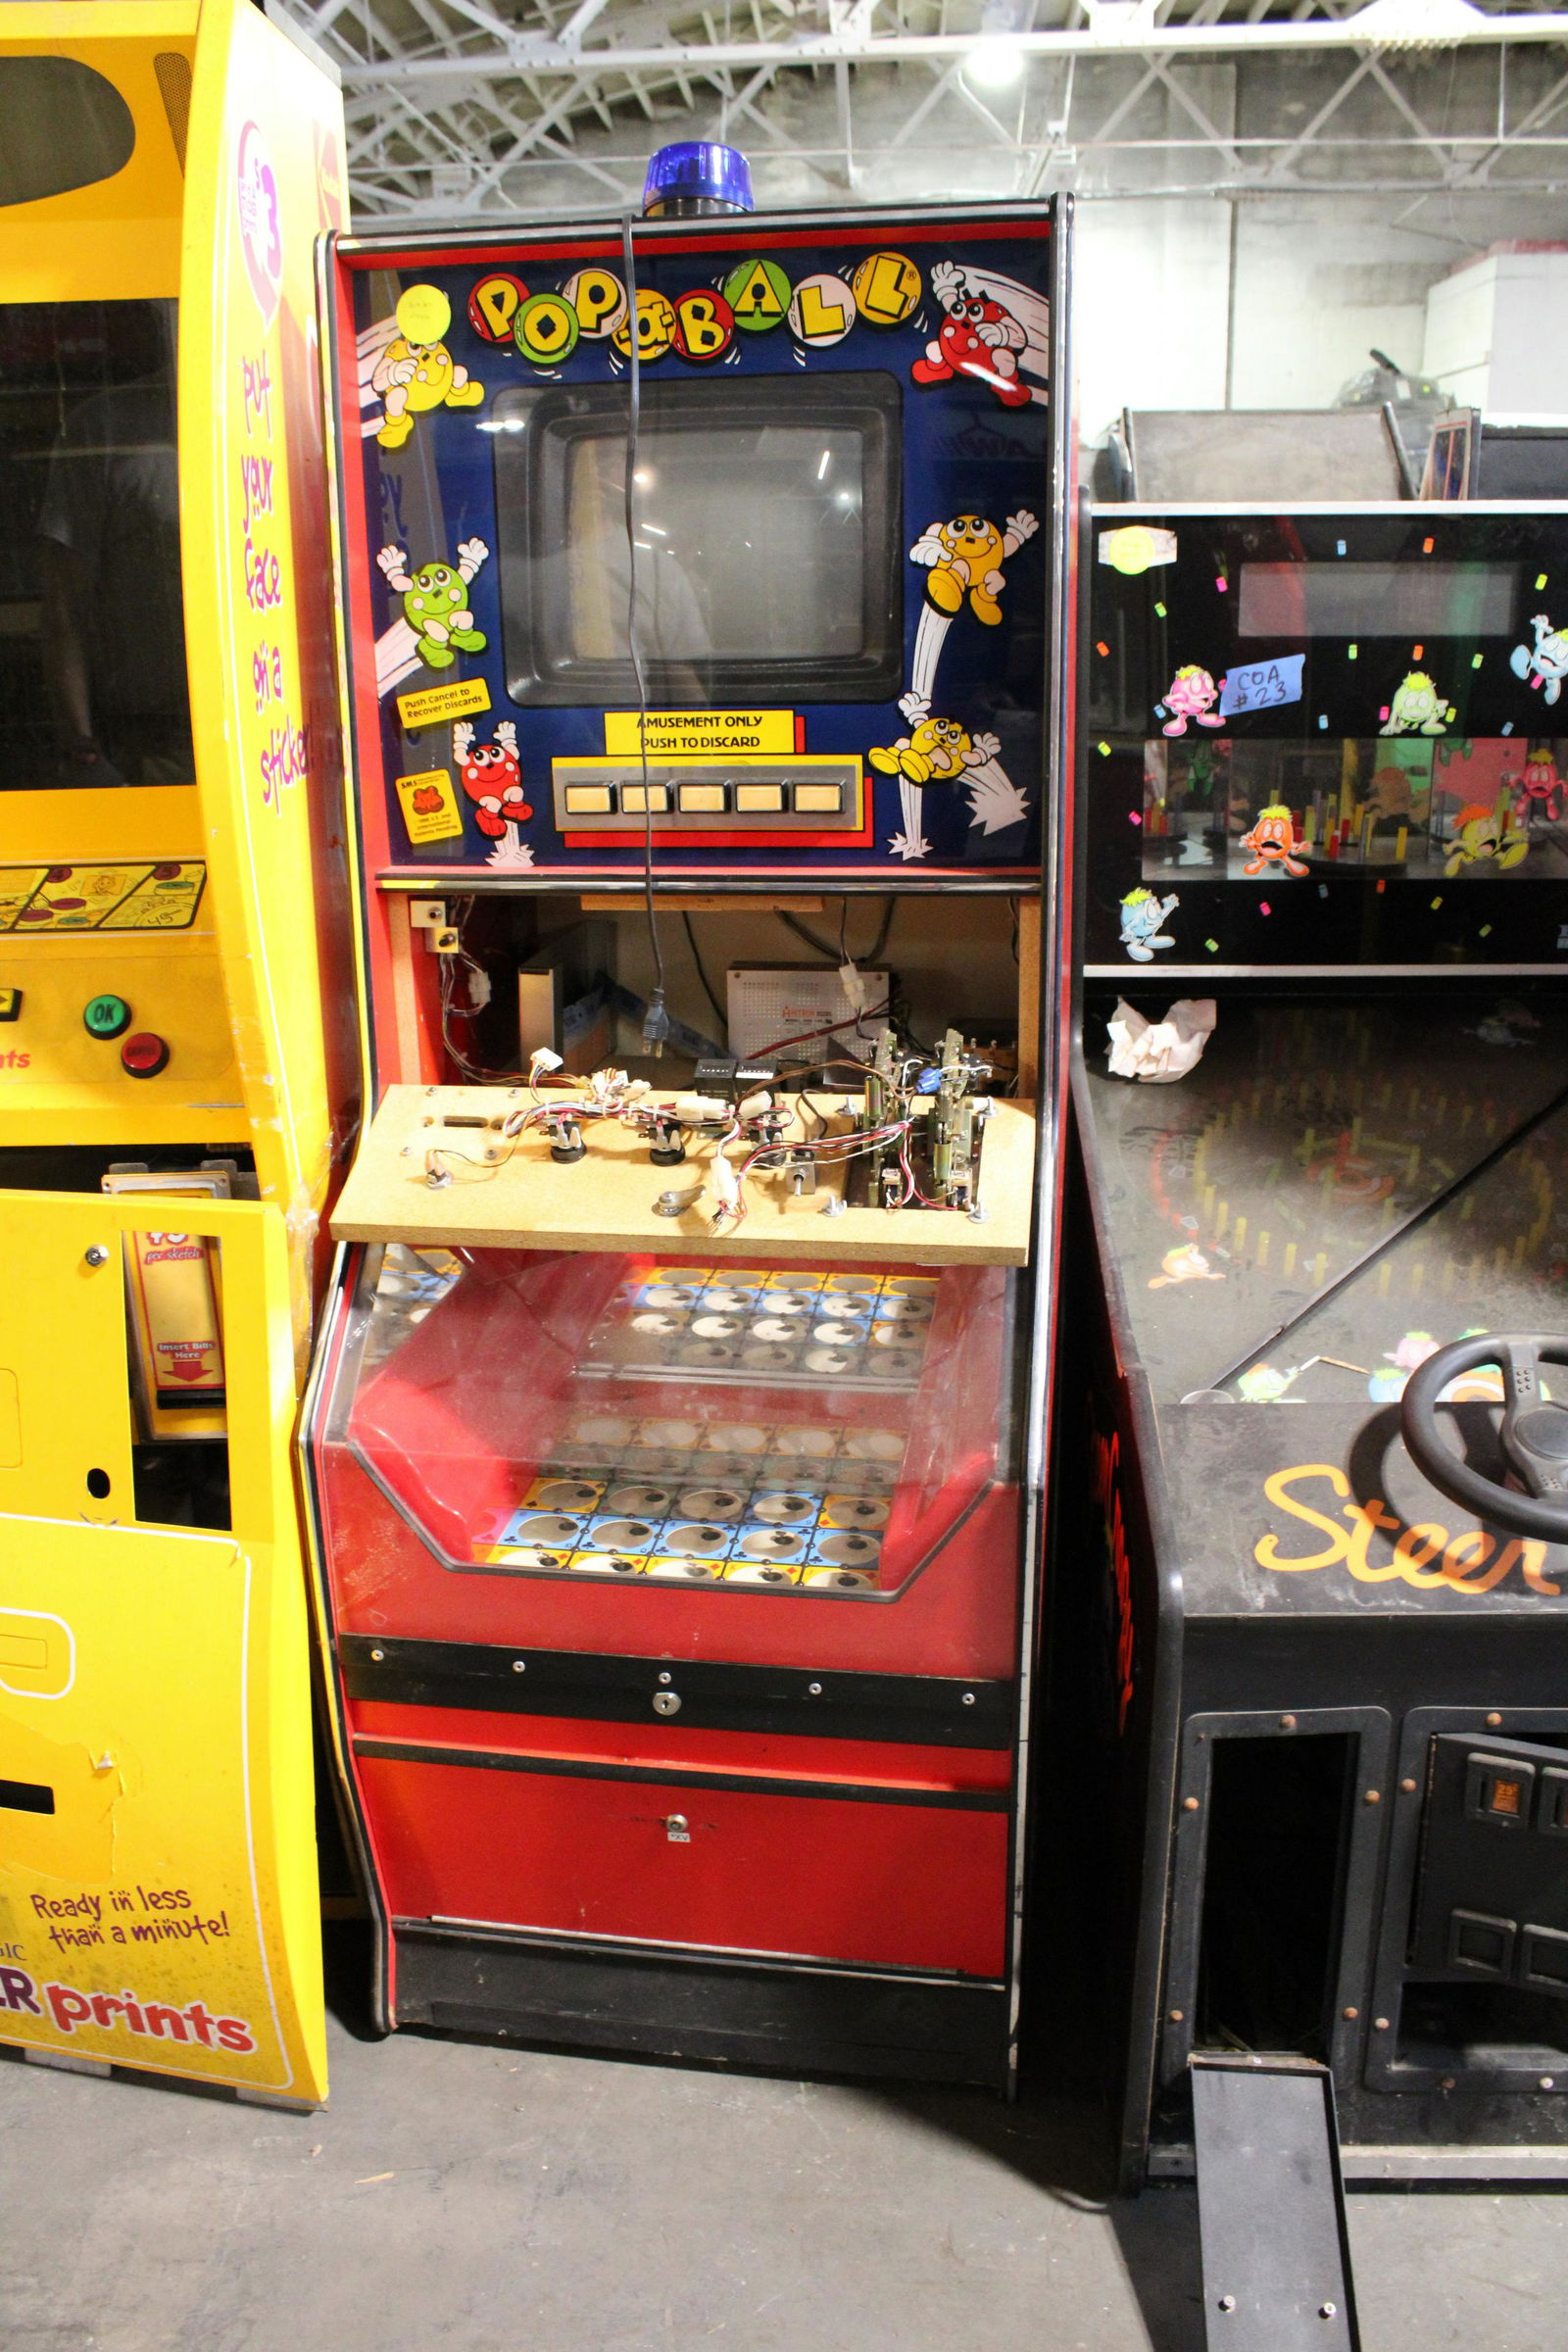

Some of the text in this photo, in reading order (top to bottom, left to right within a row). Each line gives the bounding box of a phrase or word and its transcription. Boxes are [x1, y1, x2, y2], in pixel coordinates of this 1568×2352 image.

[242, 348, 271, 441] put
[240, 454, 273, 535] your
[244, 536, 281, 610] face
[252, 639, 282, 715] on a
[1238, 665, 1279, 691] COA
[404, 698, 426, 710] Push
[428, 690, 458, 704] Cancel
[407, 695, 483, 718] Recover Discards
[637, 715, 762, 728] AMUSEMENT ONLY
[640, 736, 760, 749] PUSH TO DISCARD
[93, 1004, 118, 1023] OK
[146, 1247, 201, 1264] per sketch
[159, 1342, 215, 1351] Insert Bills
[1254, 1463, 1560, 1596] Steer
[30, 1886, 192, 1921] Ready in less
[49, 1911, 230, 1954] than a minute!
[0, 1943, 27, 1961] IC
[46, 1984, 254, 2052] prints
